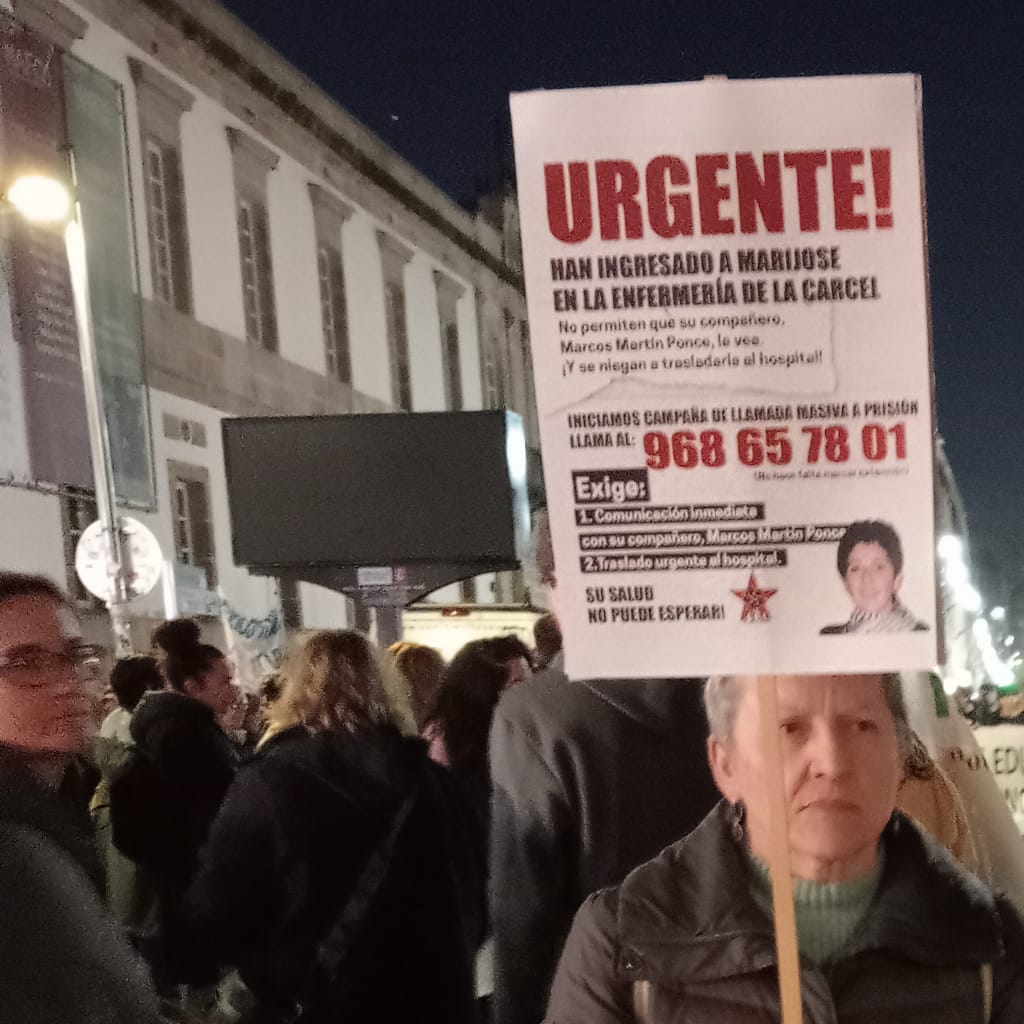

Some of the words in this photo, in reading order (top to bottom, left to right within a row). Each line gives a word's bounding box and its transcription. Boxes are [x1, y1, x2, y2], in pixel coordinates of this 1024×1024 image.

[544, 147, 894, 244] URGENTE!
[550, 256, 592, 281] HAN
[598, 251, 714, 278] INGRESADO
[719, 250, 733, 274] A
[738, 246, 841, 273] MARIJOSE
[553, 288, 578, 312] EN
[583, 286, 607, 310] LA
[612, 277, 737, 310] ENFERMERÍA
[742, 280, 769, 304] DE
[773, 278, 798, 302] LA
[802, 275, 880, 302] CARCEL
[559, 320, 577, 334] No
[581, 318, 646, 335] permiten
[650, 317, 675, 332] que
[680, 317, 696, 328] su
[700, 313, 785, 329] compañero,
[560, 339, 612, 354] Marcos
[616, 337, 664, 351] Martín
[667, 335, 715, 350] Ponce,
[580, 362, 595, 373] se
[600, 358, 647, 374] niegan
[651, 360, 658, 370] a
[662, 353, 739, 370] trasladarla
[744, 352, 755, 366] al
[759, 350, 822, 368] hospital!
[568, 411, 640, 428] INICIAMOS
[644, 406, 708, 425] CAMPAÑA
[712, 407, 727, 422] DE
[731, 405, 793, 422] LLAMADA
[797, 402, 848, 420] MASIVA
[853, 402, 861, 417] A
[865, 399, 918, 416] PRISIÓN
[570, 433, 613, 448] LLAMA
[616, 431, 636, 447] AL:
[643, 429, 726, 470] 968
[737, 426, 792, 467] 65
[801, 424, 850, 464] 78
[861, 422, 907, 461] 01
[575, 475, 646, 502] Exige:
[580, 510, 593, 523] 1.
[594, 505, 688, 523] Comunicación
[691, 504, 758, 520] inmediata
[581, 534, 608, 547] con
[608, 534, 625, 546] su
[627, 531, 705, 549] compañero,
[706, 529, 755, 544] Marcos
[654, 555, 706, 570] urgente
[709, 552, 721, 567] al
[586, 586, 604, 603] SU
[608, 585, 654, 602] SALUD
[588, 606, 607, 623] NO
[611, 605, 655, 622] PUEDE
